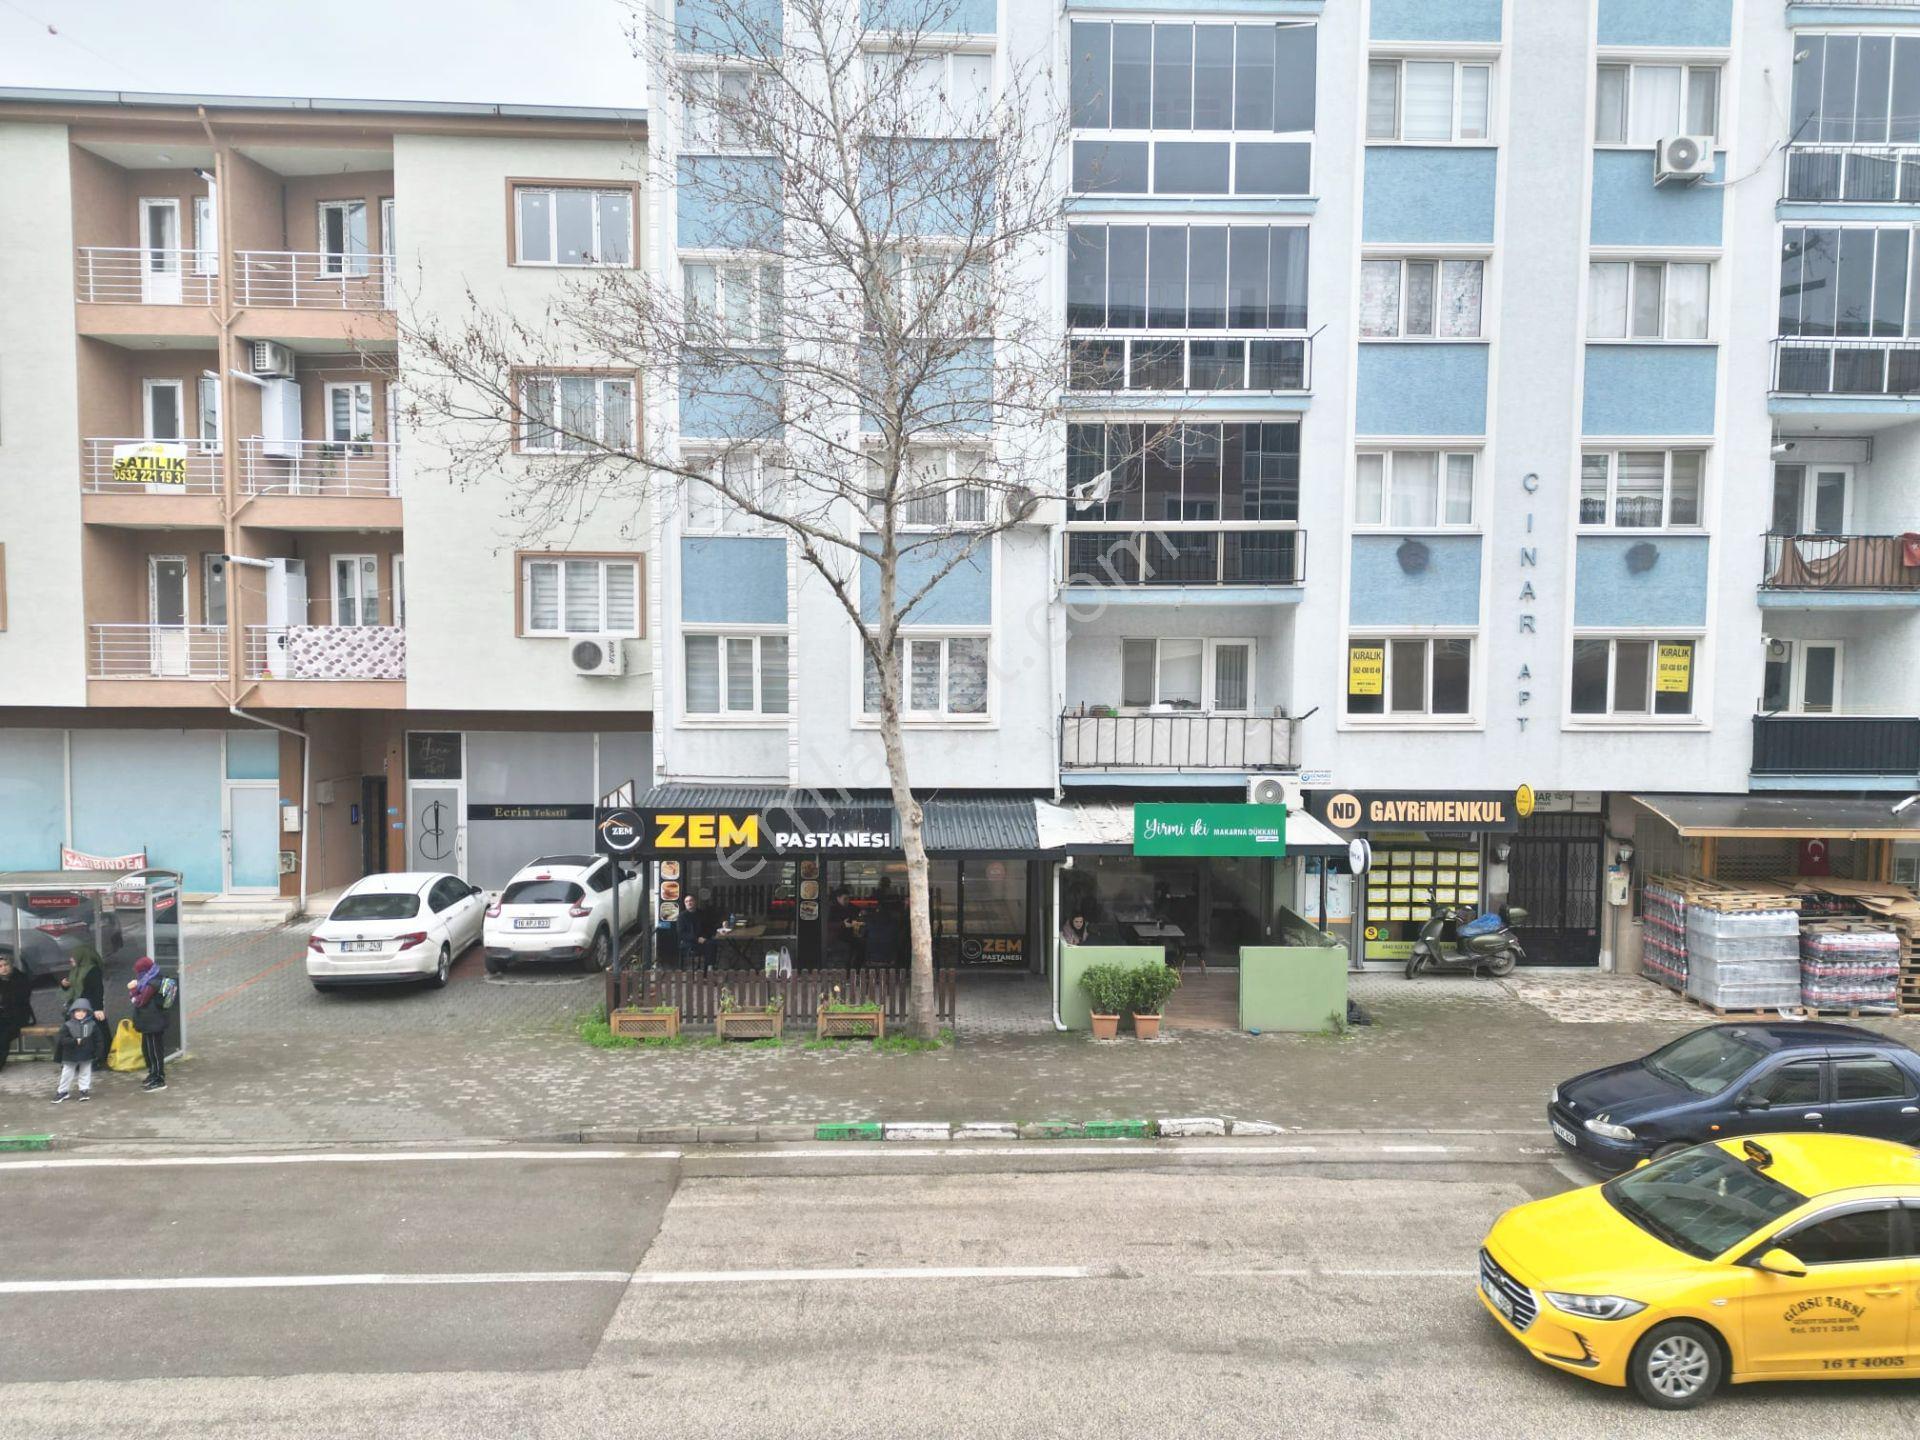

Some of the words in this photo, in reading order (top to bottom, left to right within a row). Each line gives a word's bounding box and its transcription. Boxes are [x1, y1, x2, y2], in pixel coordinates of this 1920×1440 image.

[115, 457, 185, 470] SATILIK
[114, 470, 138, 481] 0532
[140, 470, 158, 482] 221
[160, 471, 173, 483] 19
[1519, 472, 1539, 633] ÇINAR
[1517, 663, 1532, 732] APT
[495, 807, 530, 817] Ecrin
[534, 808, 567, 817] Tekstil
[1332, 803, 1355, 819] ND
[611, 827, 633, 836] ZEM
[655, 814, 759, 848] ZEM
[1144, 818, 1186, 840] Yirmi
[1190, 818, 1210, 837] iki
[1213, 828, 1247, 836] MAKARNA
[1248, 826, 1279, 837] DÜKKANI
[982, 939, 1022, 952] ZEM
[1783, 1297, 1822, 1322] GÜRSU
[1822, 1359, 1843, 1369] 16
[1862, 1356, 1905, 1368] 4005
